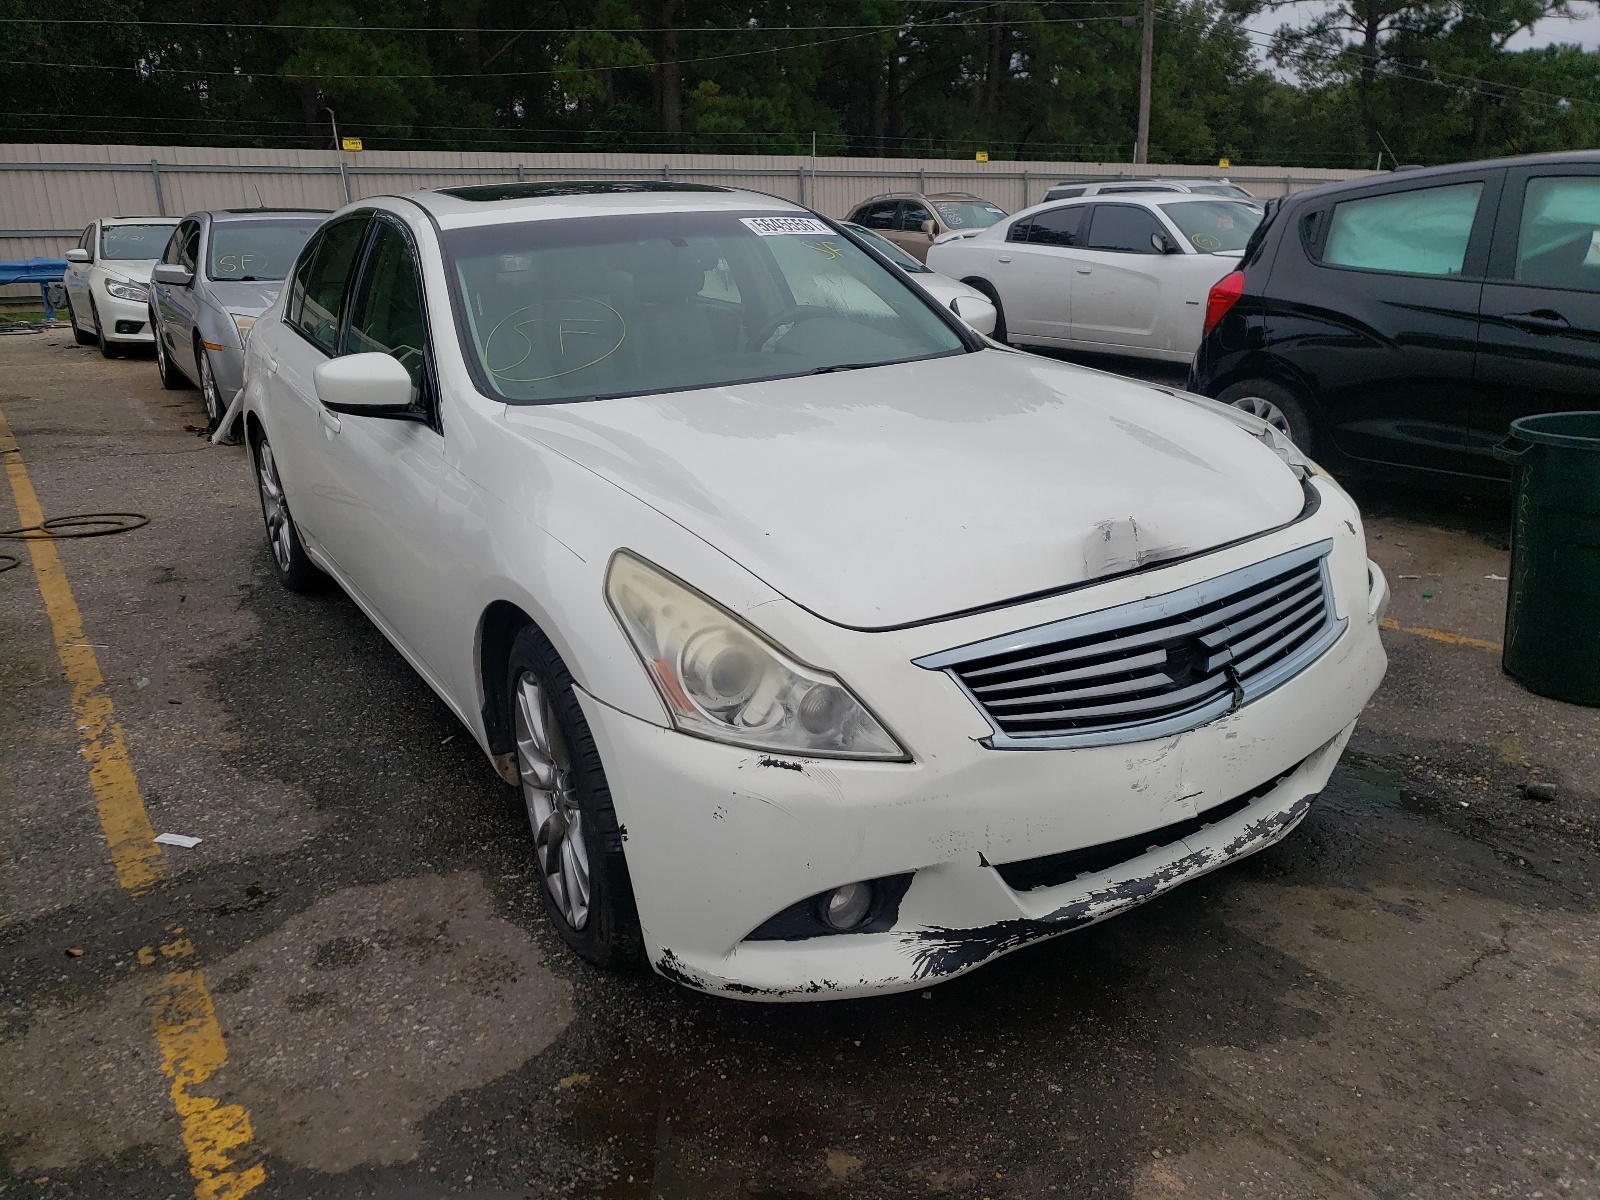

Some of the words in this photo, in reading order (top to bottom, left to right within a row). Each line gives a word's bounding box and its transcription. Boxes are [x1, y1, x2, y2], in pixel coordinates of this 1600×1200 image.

[752, 218, 822, 231] 56455561
[219, 254, 255, 272] SF
[490, 318, 607, 373] SF
